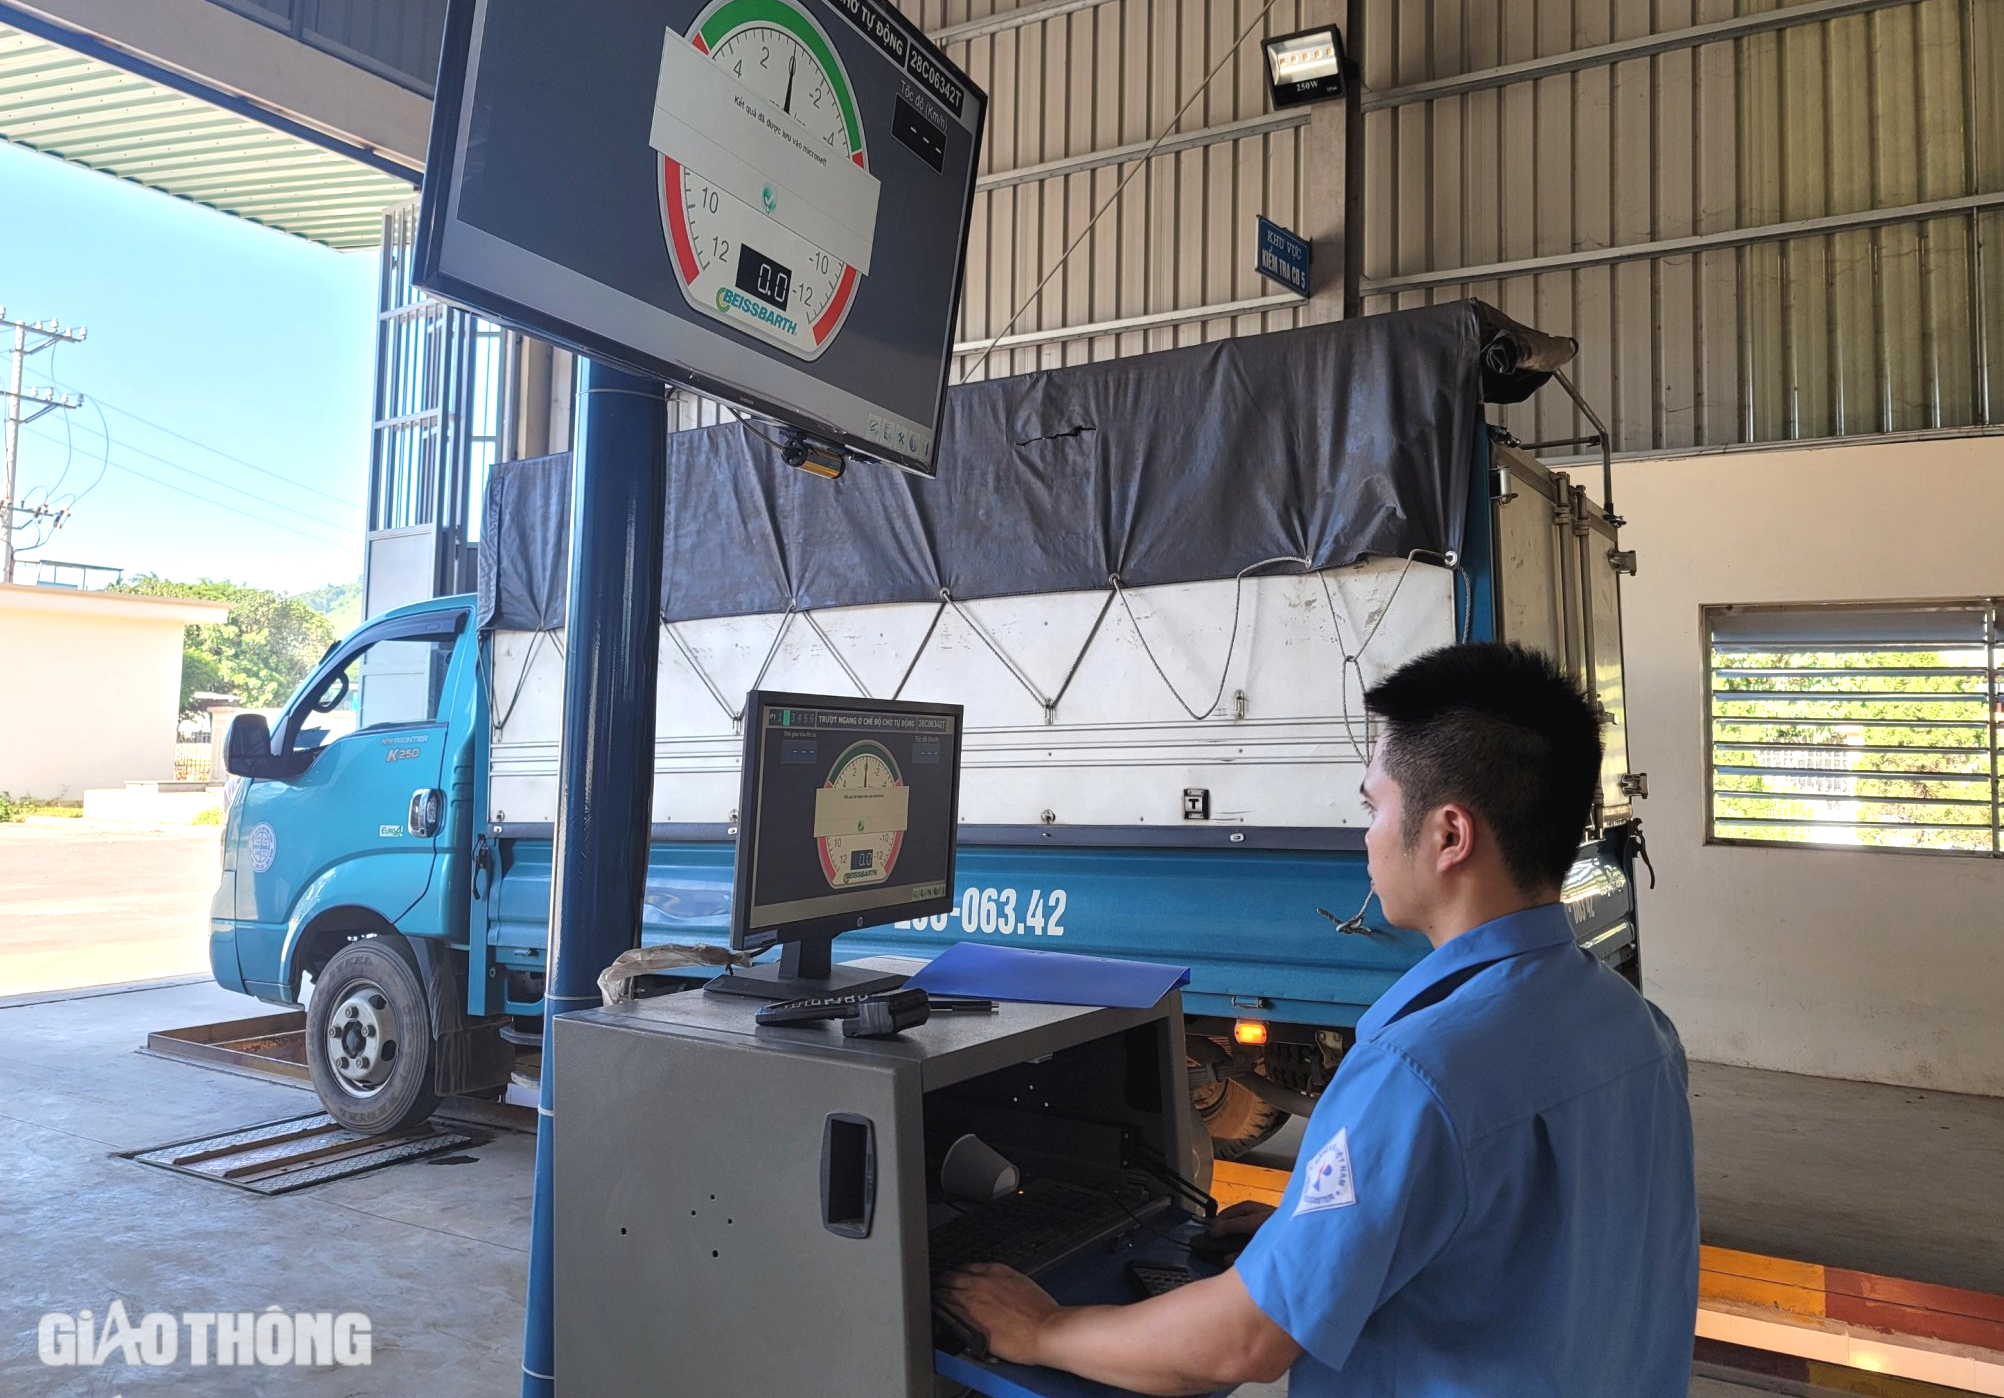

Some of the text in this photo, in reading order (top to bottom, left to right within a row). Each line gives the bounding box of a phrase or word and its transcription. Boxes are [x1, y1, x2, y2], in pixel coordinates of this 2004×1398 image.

[861, 5, 876, 31] TỰ
[876, 20, 904, 56] ĐỘNG
[733, 59, 742, 78] 4
[760, 46, 770, 69] 2
[910, 50, 962, 108] 28C06342T
[809, 87, 822, 109] -2
[823, 132, 835, 147] -4
[702, 186, 719, 214] 10
[712, 235, 730, 263] 12
[1267, 230, 1302, 260] KHU VỰC
[808, 251, 829, 275] -10
[1262, 246, 1278, 273] KIỂM
[1279, 259, 1291, 281] TRA
[1300, 272, 1306, 289] 5
[757, 263, 788, 303] 0.0
[792, 283, 813, 307] -12
[722, 288, 798, 336] BEISSBARTH
